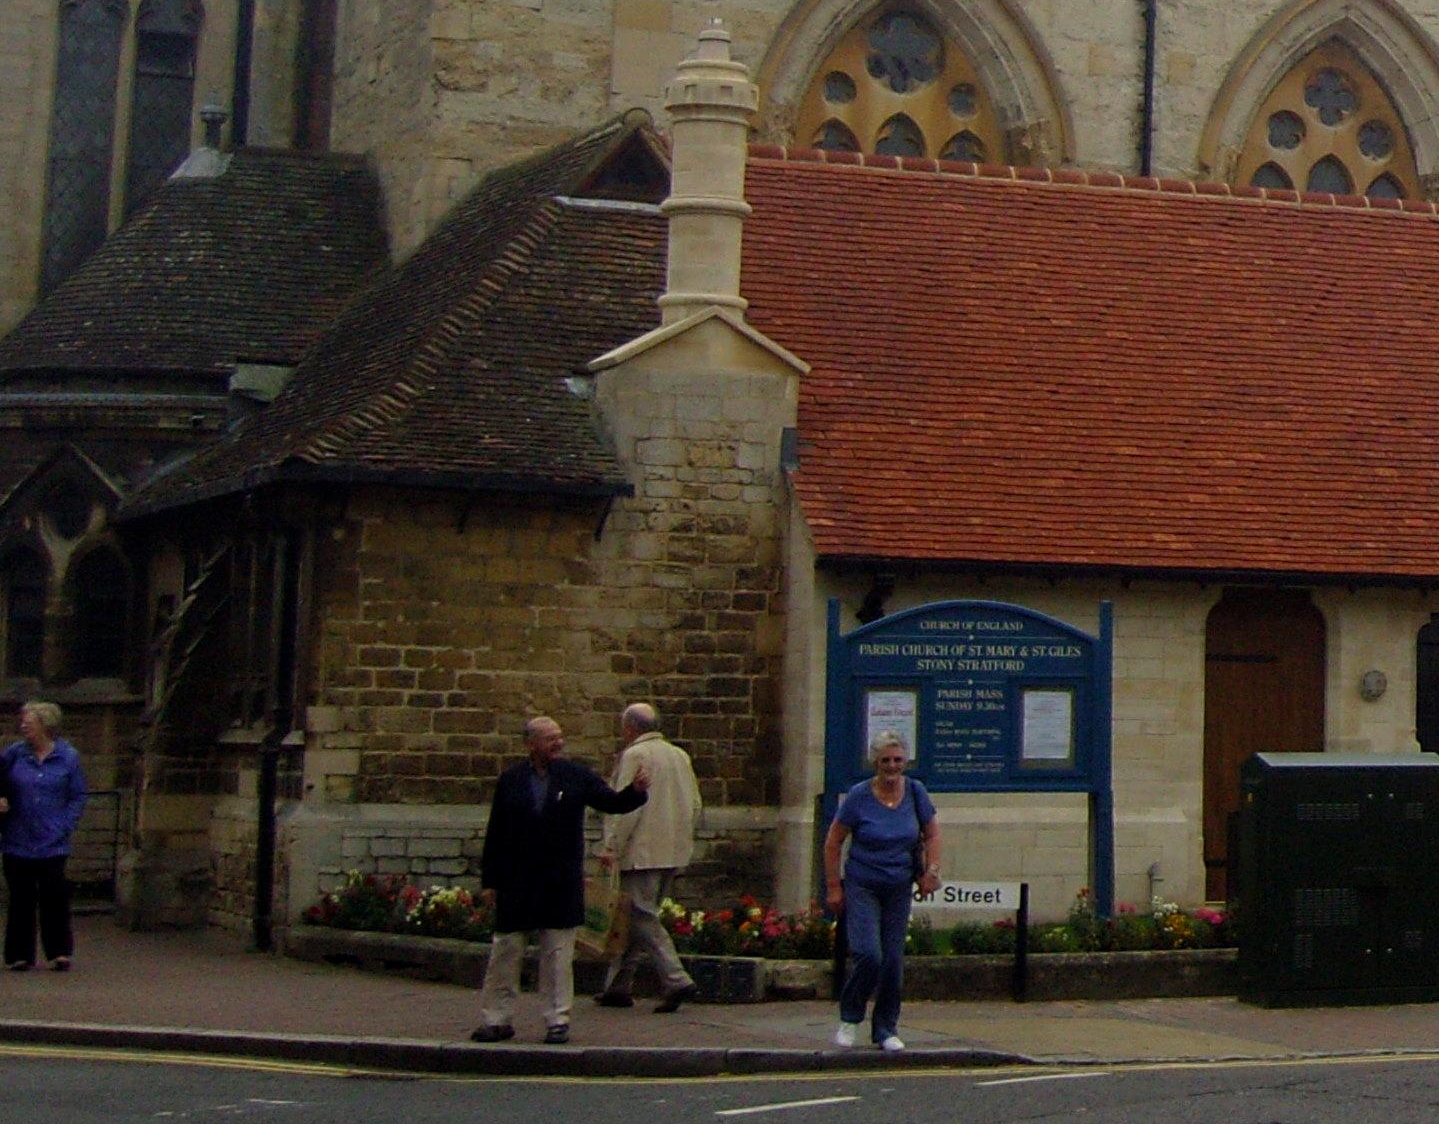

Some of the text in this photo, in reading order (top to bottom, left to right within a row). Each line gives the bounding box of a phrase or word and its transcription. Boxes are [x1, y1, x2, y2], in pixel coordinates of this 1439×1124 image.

[920, 620, 1024, 631] CHURCH OF ENGLAND
[860, 644, 899, 655] PARISH
[902, 644, 948, 656] CHURCH
[950, 644, 966, 656] OF
[986, 645, 1017, 657] MARY
[1020, 645, 1028, 657] &
[917, 659, 1025, 671] STONY STRATFORD
[944, 886, 1001, 903] Street
